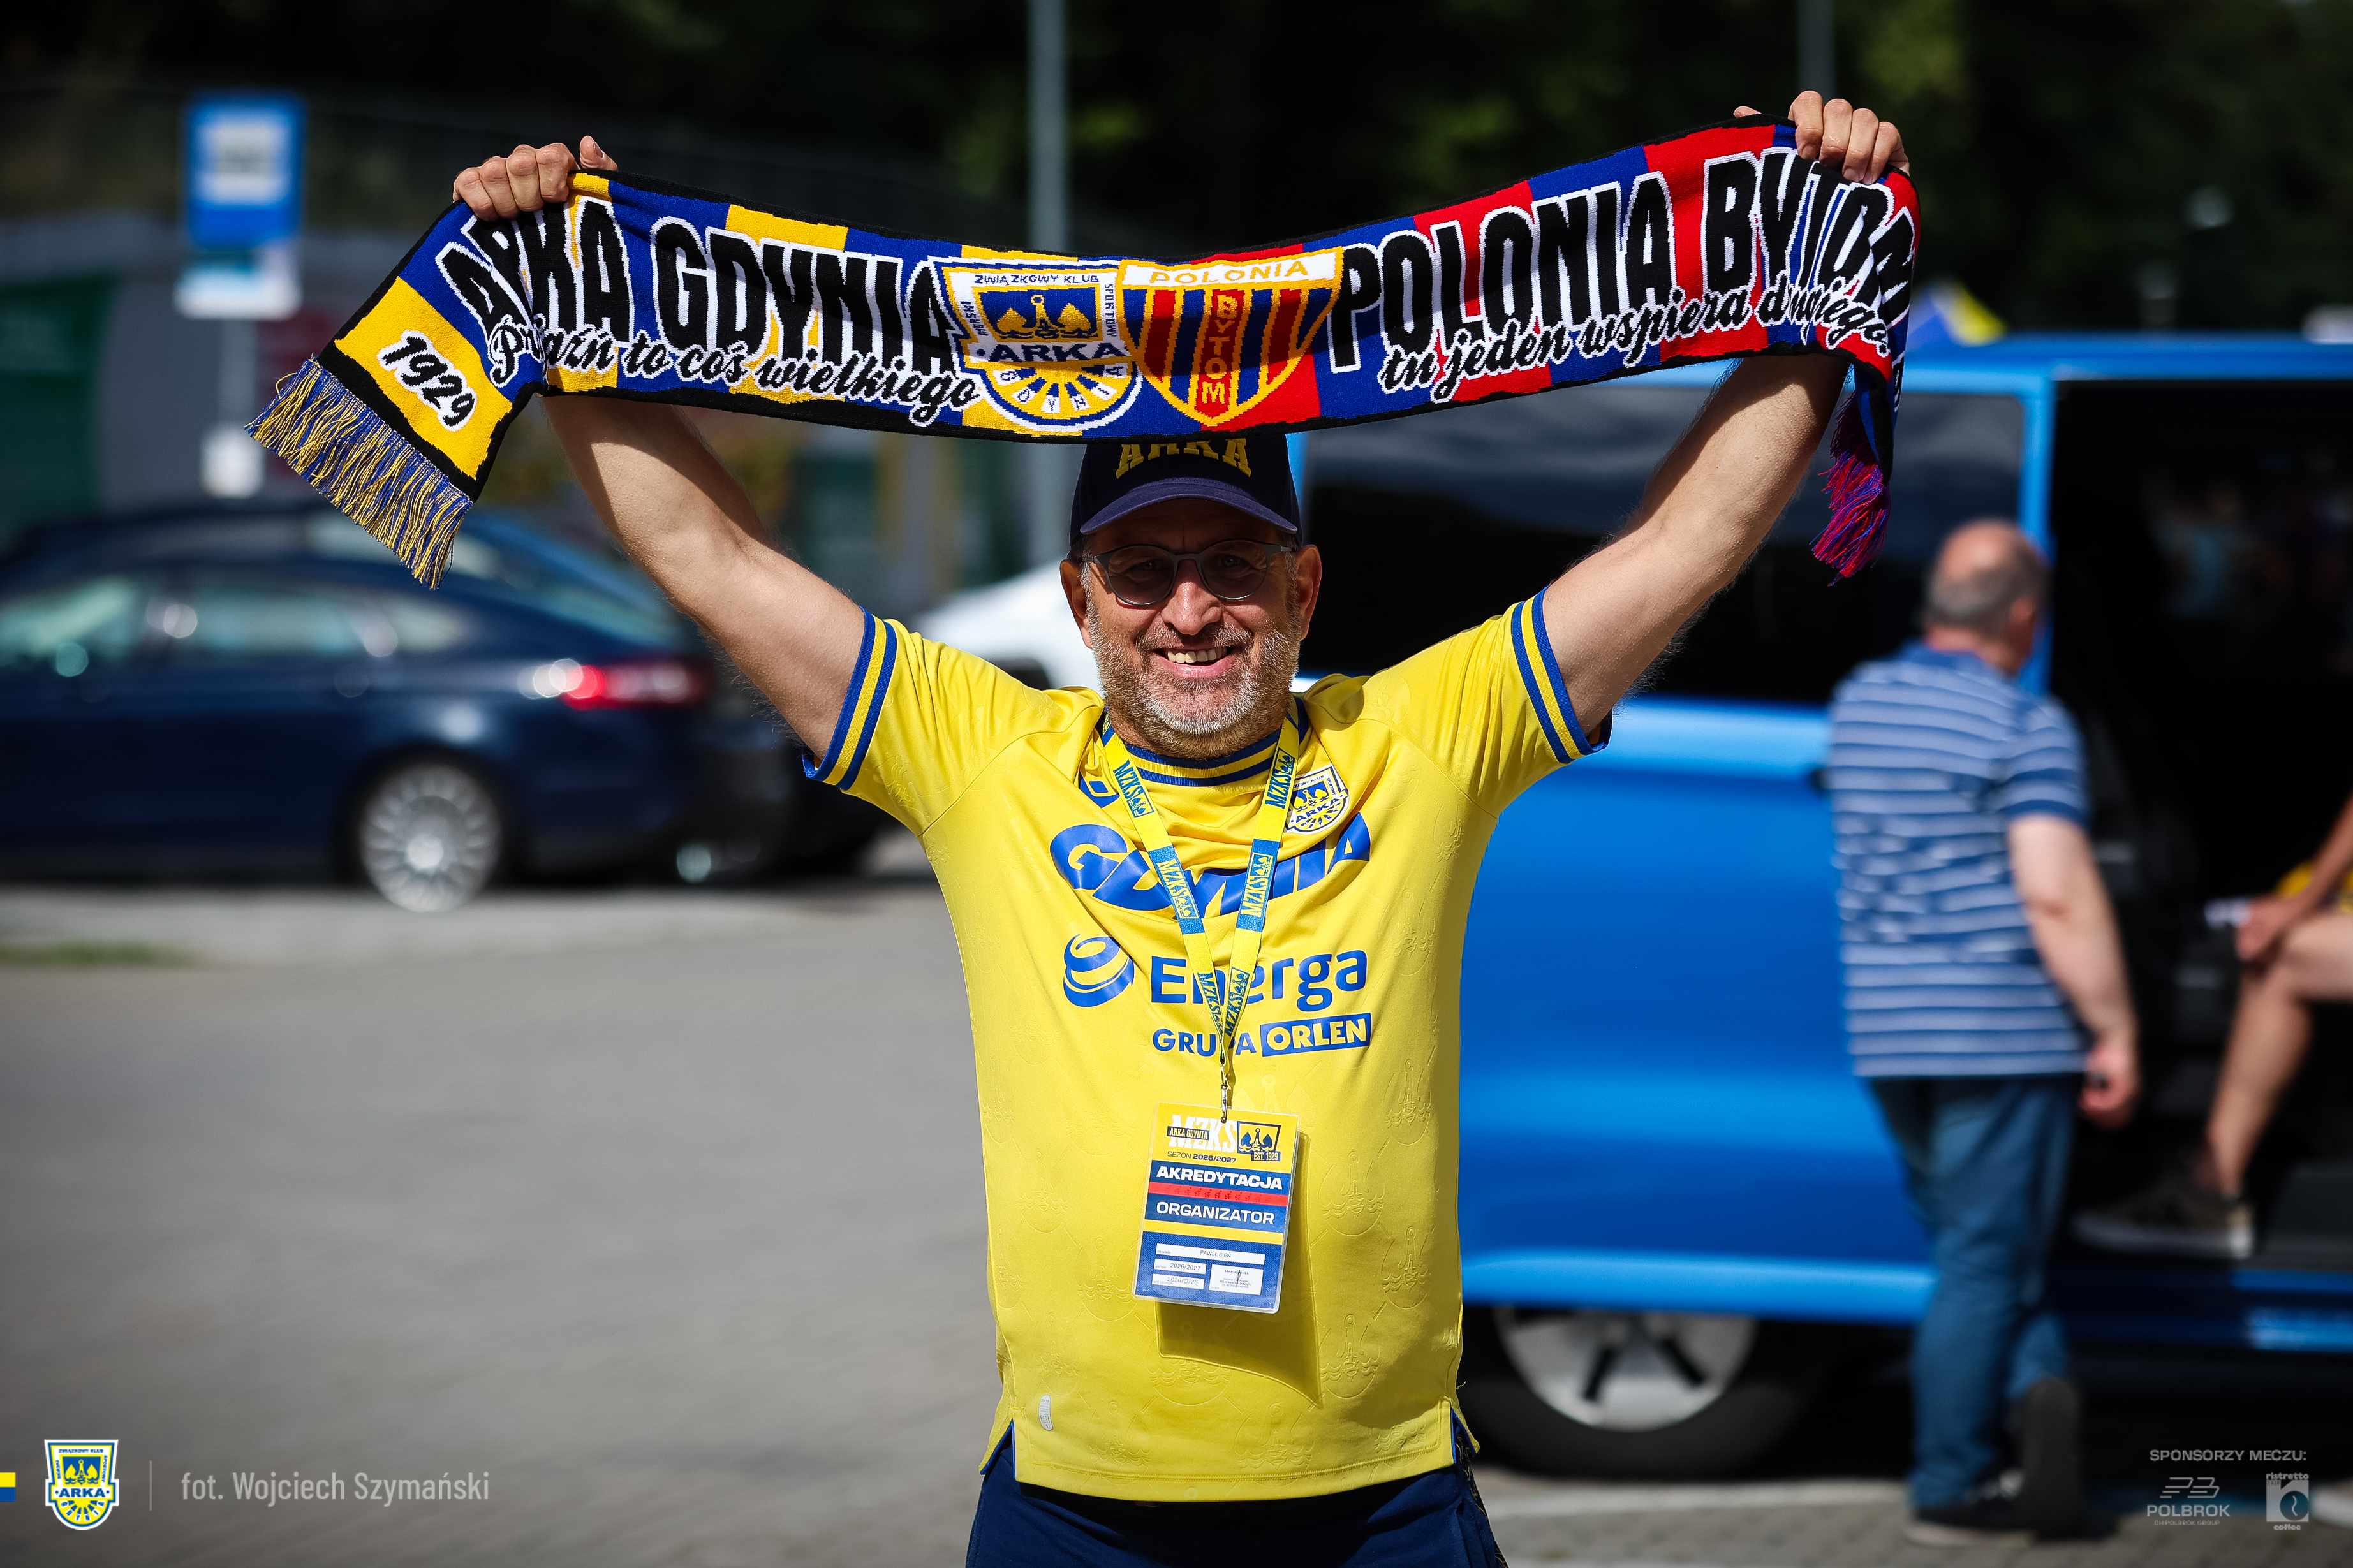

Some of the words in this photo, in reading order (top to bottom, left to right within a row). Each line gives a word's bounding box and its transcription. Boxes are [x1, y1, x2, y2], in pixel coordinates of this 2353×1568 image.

[1064, 275, 1099, 284] KLUB
[1150, 261, 1308, 283] POLONIA
[1327, 171, 1678, 374] POLONIA
[651, 216, 961, 375] GDYNIA
[1104, 284, 1117, 337] SPORTOWY
[988, 343, 1128, 362] ARKA
[1202, 295, 1238, 404] BYTOM
[1377, 345, 1440, 394] tu
[1430, 319, 1574, 403] jeden
[1575, 285, 1754, 368] wspiera
[377, 330, 476, 432] 1929
[623, 329, 674, 379] to
[675, 339, 748, 384] coś
[755, 346, 982, 428] wielkiego
[1113, 759, 1146, 799] MZKS
[1265, 769, 1292, 809] MZKS
[1295, 798, 1339, 823] ARKA
[1156, 858, 1188, 897] MZKS
[1241, 876, 1269, 917] MZKS
[1197, 972, 1221, 1015] MZKS
[1224, 992, 1243, 1037] MZKS
[1153, 1029, 1257, 1057] GRUA
[1266, 1018, 1366, 1051] ORLEN
[1169, 1127, 1185, 1137] ARKA
[1186, 1129, 1208, 1139] GDYNIA
[1169, 1115, 1237, 1153] MZKS
[1193, 1154, 1236, 1163] 2026/2027
[1253, 1152, 1265, 1161] EST.
[1265, 1152, 1278, 1161] 1929
[1156, 1166, 1283, 1190] AKREDYTACJA
[1156, 1201, 1275, 1225] ORGANIZATOR
[1170, 1263, 1200, 1271] 2026/2027
